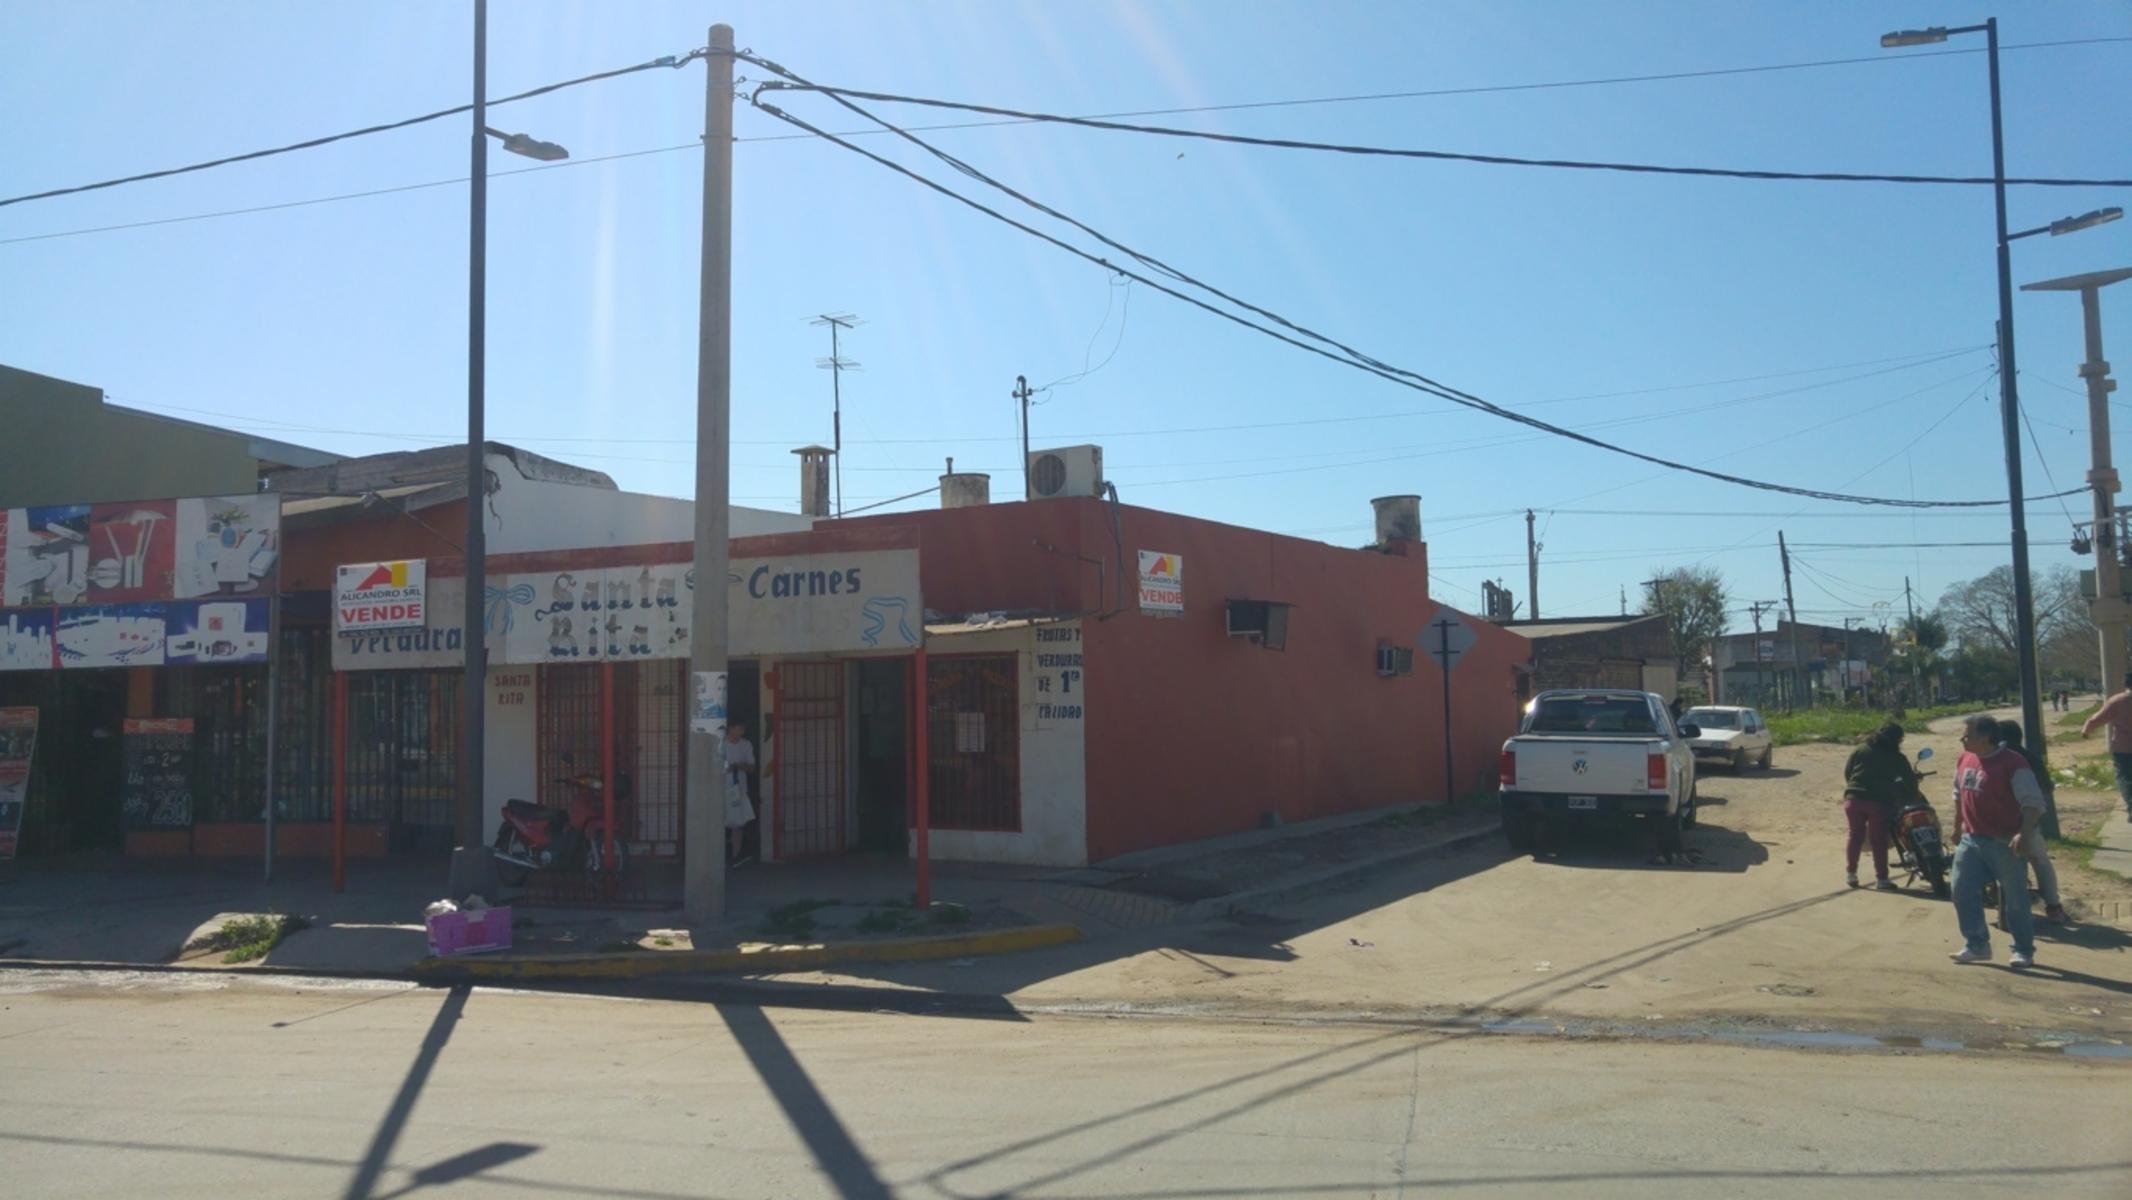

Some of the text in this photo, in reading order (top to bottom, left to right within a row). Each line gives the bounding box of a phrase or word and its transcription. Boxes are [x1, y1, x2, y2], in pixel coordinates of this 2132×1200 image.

[749, 565, 861, 599] Carnes
[340, 588, 422, 601] ALICANDRO SRL
[535, 567, 679, 621] Santa
[1141, 589, 1184, 604] VENDE
[341, 604, 421, 624] VENDE
[351, 627, 463, 655] Verdura
[548, 614, 652, 656] Rita
[1036, 628, 1072, 642] FRUTAS
[1037, 654, 1084, 667] VERDURAS
[495, 674, 530, 687] SANTA
[1038, 678, 1051, 692] DE
